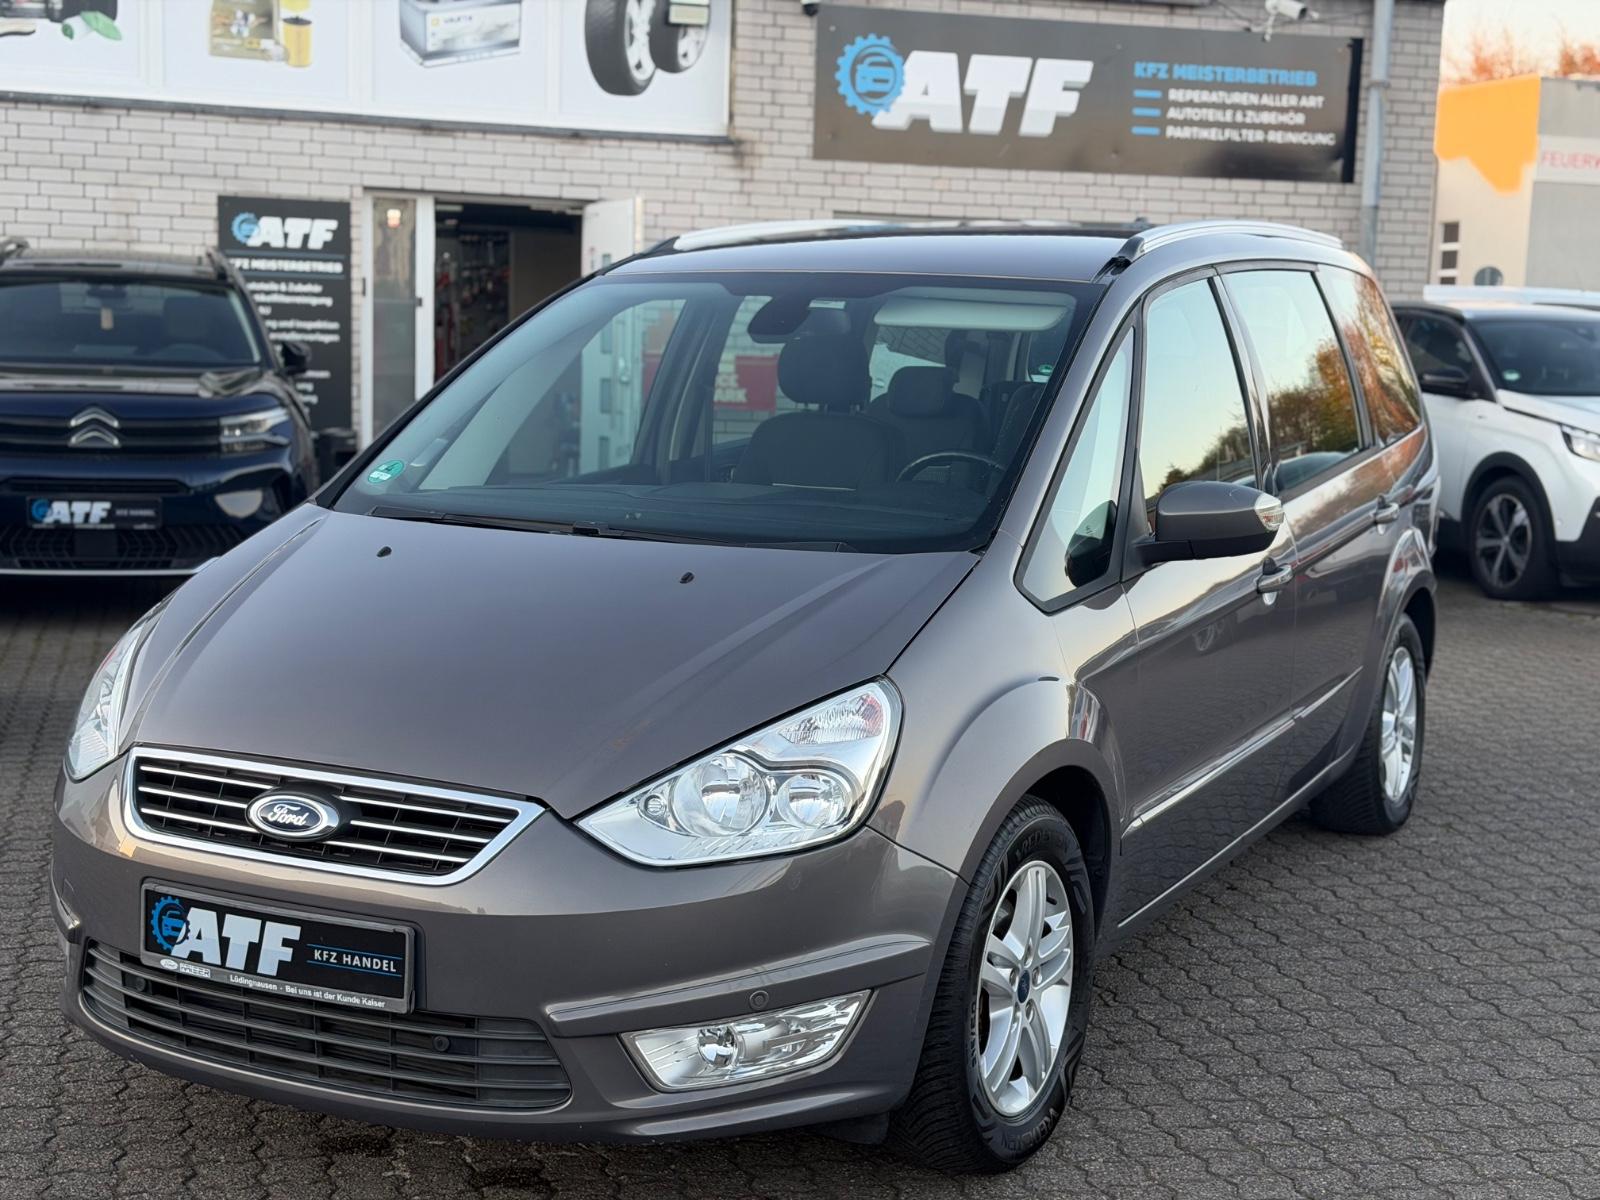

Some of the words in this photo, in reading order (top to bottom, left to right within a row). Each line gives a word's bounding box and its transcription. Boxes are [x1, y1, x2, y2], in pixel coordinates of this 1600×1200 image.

[1134, 61, 1169, 80] KFZ
[1172, 64, 1318, 87] MEISTERBETRIEB
[872, 50, 1094, 137] ATF
[1260, 93, 1299, 107] ALLER
[1299, 95, 1325, 109] ART
[1166, 107, 1233, 123] AUTOTEILE
[1245, 109, 1306, 125] ZUBEHÖR
[247, 216, 338, 250] ATF
[43, 501, 112, 524] ATF
[268, 803, 309, 826] Ford
[171, 906, 301, 976] ATF
[313, 949, 338, 963] KFZ
[342, 953, 397, 972] HANDEL
[285, 985, 297, 994] Bei
[298, 988, 312, 996] uns
[313, 989, 322, 998] ist
[323, 991, 335, 1000] der
[336, 993, 361, 1004] Kunde
[362, 997, 386, 1008] Kaiser
